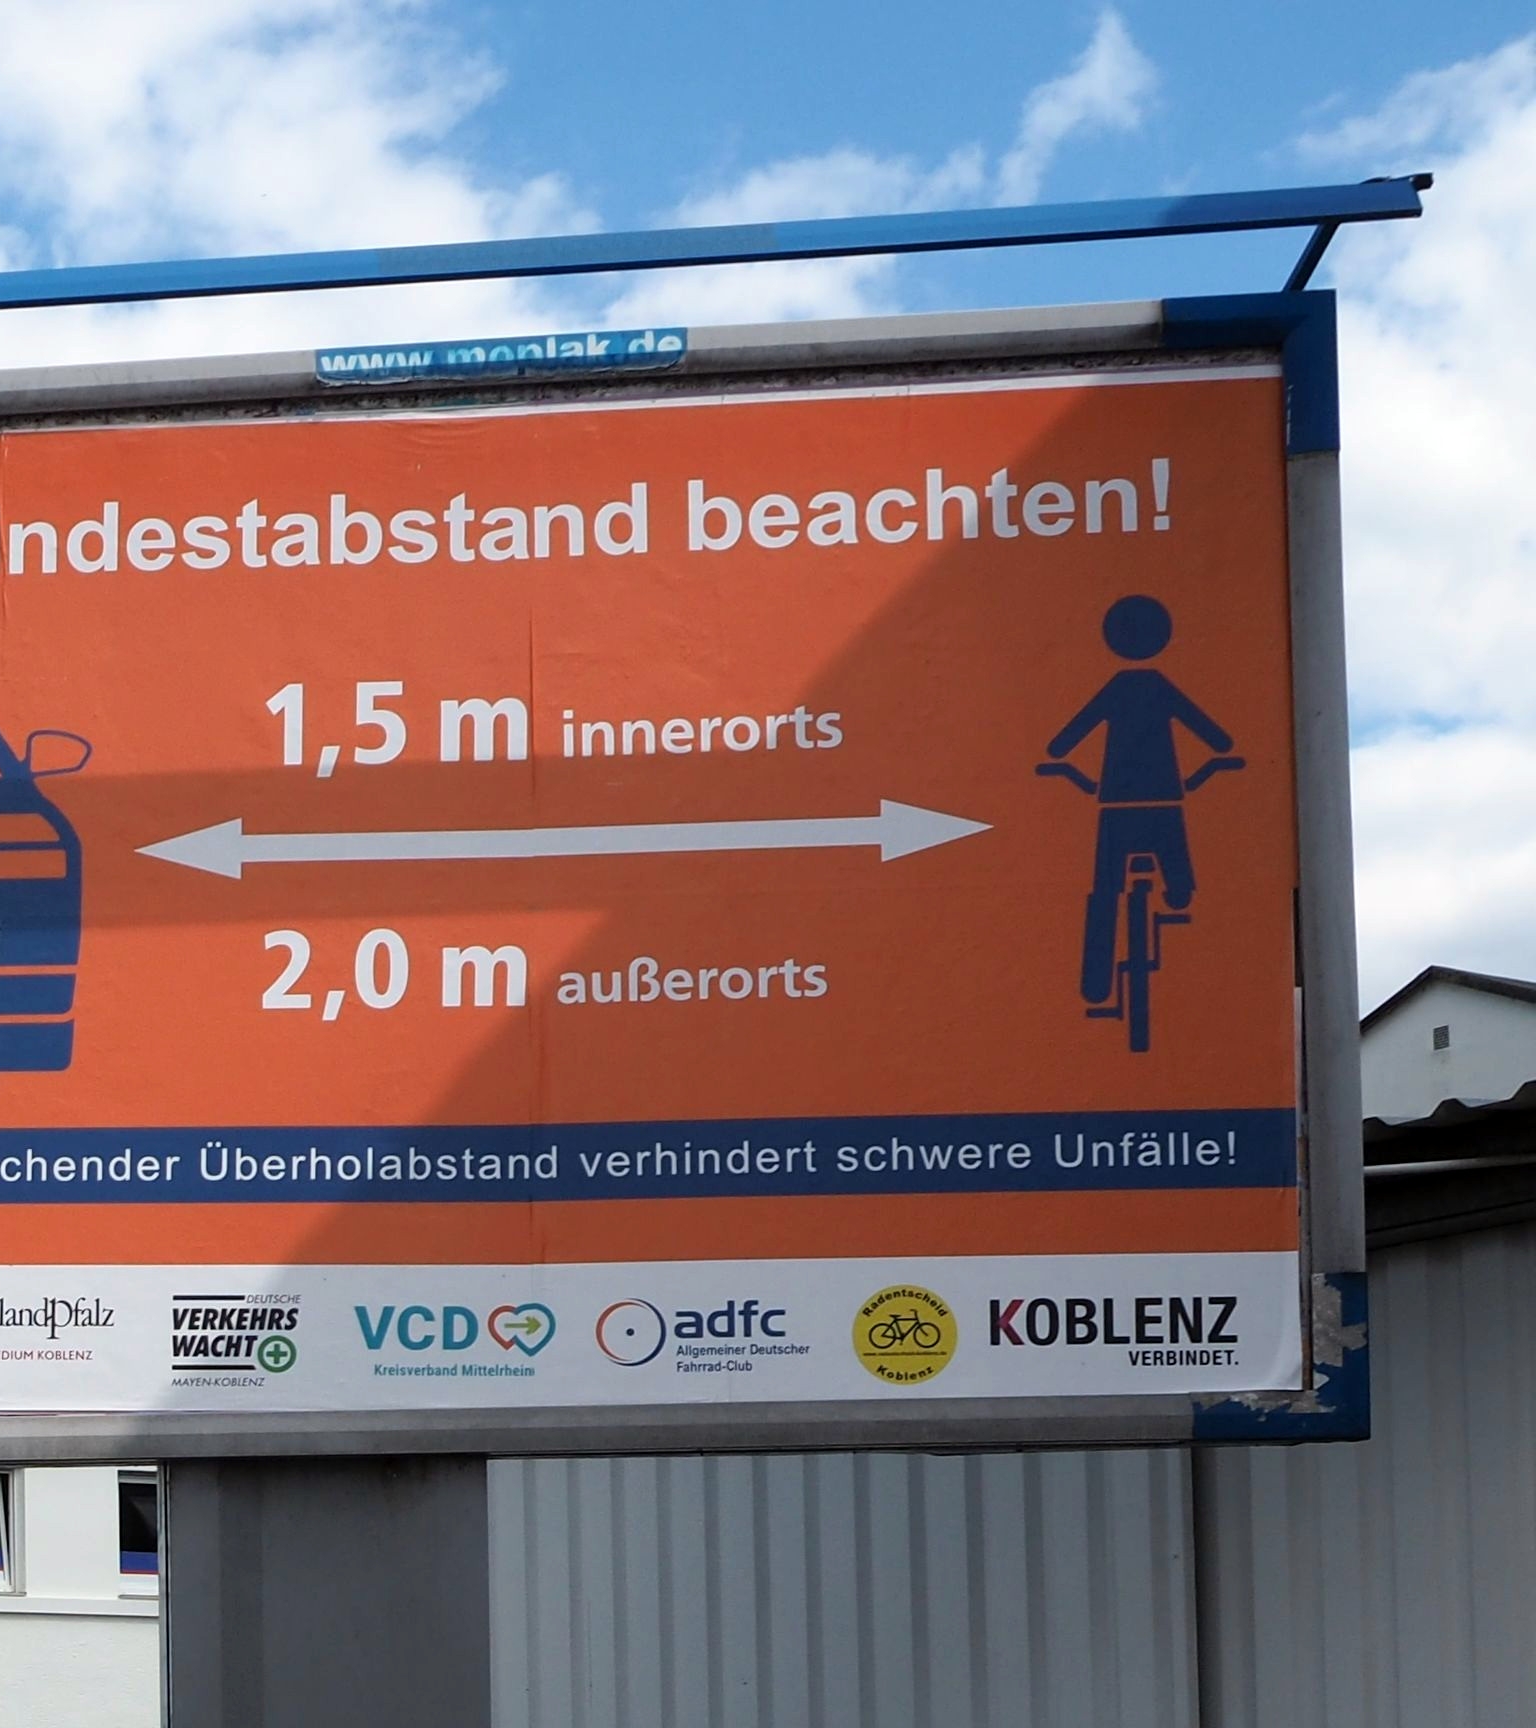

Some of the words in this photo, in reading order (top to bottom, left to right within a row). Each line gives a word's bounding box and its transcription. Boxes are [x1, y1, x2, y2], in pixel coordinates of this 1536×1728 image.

[687, 458, 1170, 551] beachten!
[265, 680, 408, 778] 1,5
[440, 697, 528, 761] m
[562, 705, 843, 758] innerorts
[262, 928, 409, 1021] 2,0
[441, 945, 527, 1008] m
[557, 956, 829, 1004] außerorts
[199, 1142, 559, 1181] Überholabstand
[579, 1140, 817, 1177] verhindert
[836, 1136, 1033, 1173] schwere
[1054, 1131, 1238, 1169] Unfälle!
[246, 1294, 301, 1305] DEUTSCHE
[862, 1289, 948, 1317] Radentscheid
[171, 1307, 298, 1331] VERKEHRS
[354, 1305, 479, 1351] VCD
[674, 1300, 786, 1338] adfc
[989, 1297, 1238, 1346] KOBLENZ
[38, 1349, 93, 1361] KOBLENZ
[171, 1334, 258, 1358] WACHT
[676, 1344, 746, 1358] Allgemeiner
[750, 1343, 810, 1356] Deutscher
[1129, 1349, 1239, 1367] VERBINDET.
[374, 1363, 457, 1377] Kreisverband
[462, 1363, 535, 1377] Mittelrhein
[676, 1360, 753, 1373] Fahrrad-Club
[876, 1364, 934, 1381] Koblenz
[171, 1376, 265, 1387] MAYEN-KOBLENZ
